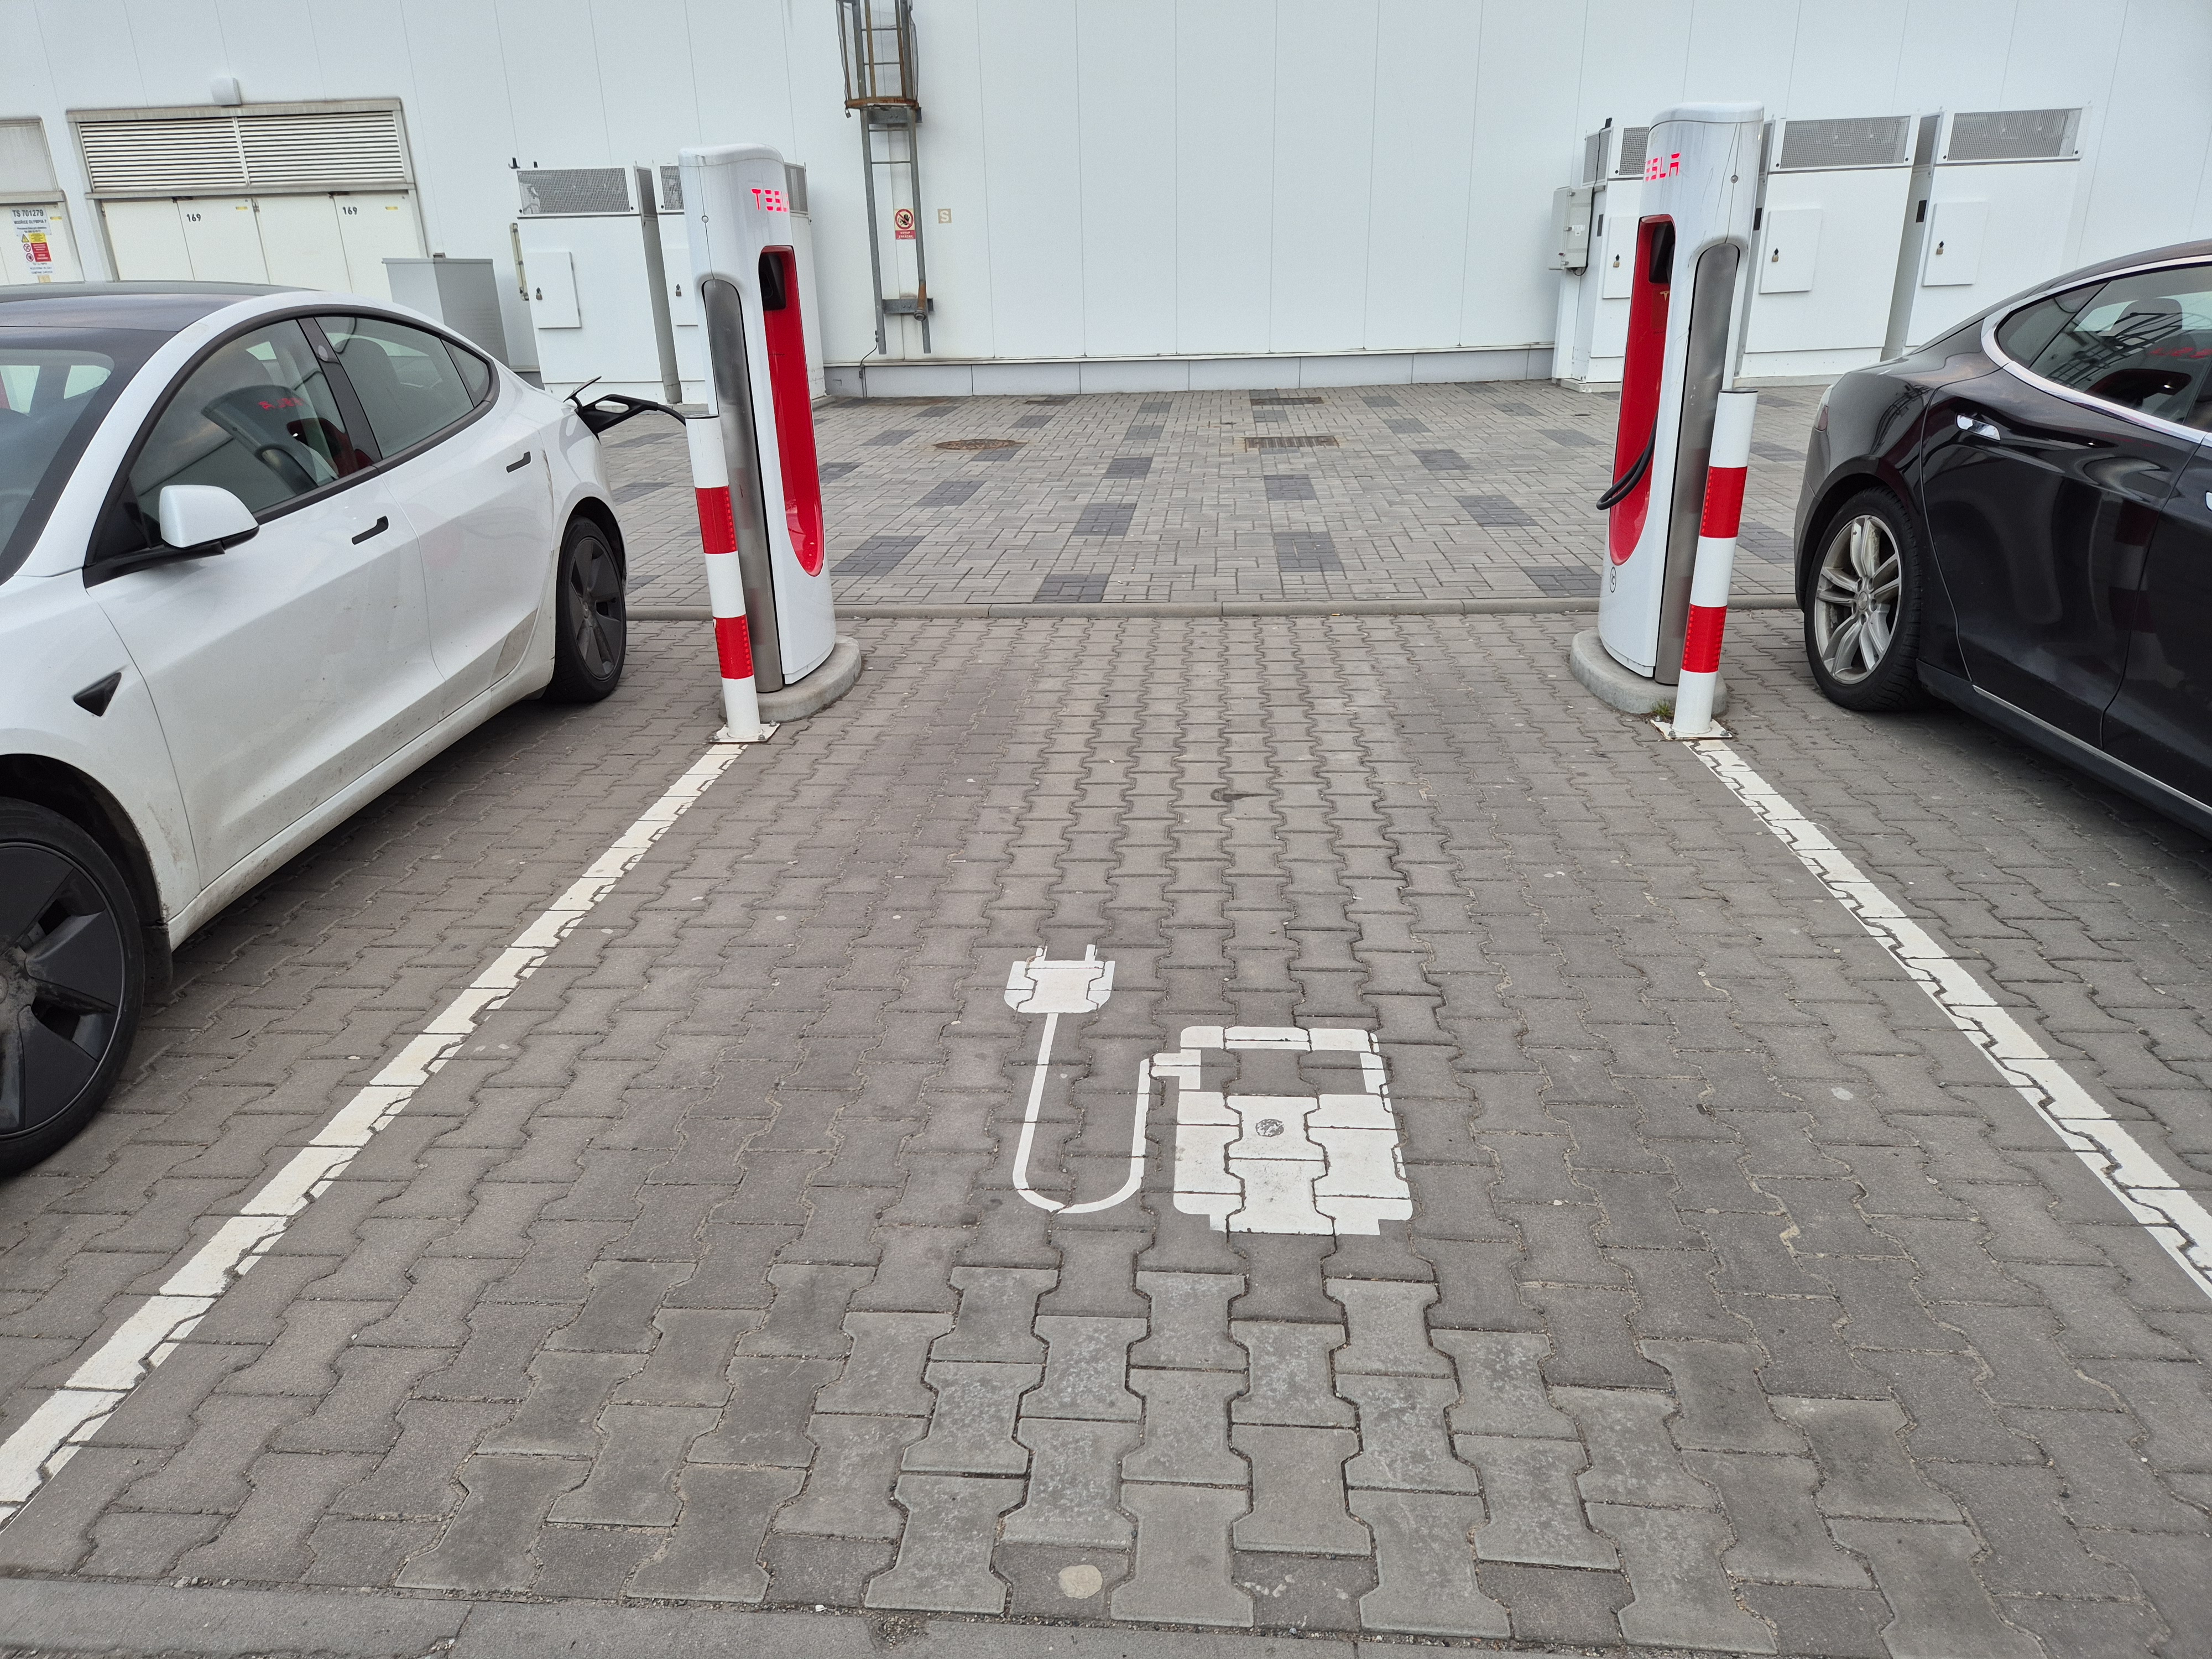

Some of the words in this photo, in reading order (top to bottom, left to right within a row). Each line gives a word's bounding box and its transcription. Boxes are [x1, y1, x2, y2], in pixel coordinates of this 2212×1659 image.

[1645, 153, 1680, 182] ESLA
[342, 206, 357, 215] 169
[186, 213, 201, 222] 169
[940, 210, 950, 222] S
